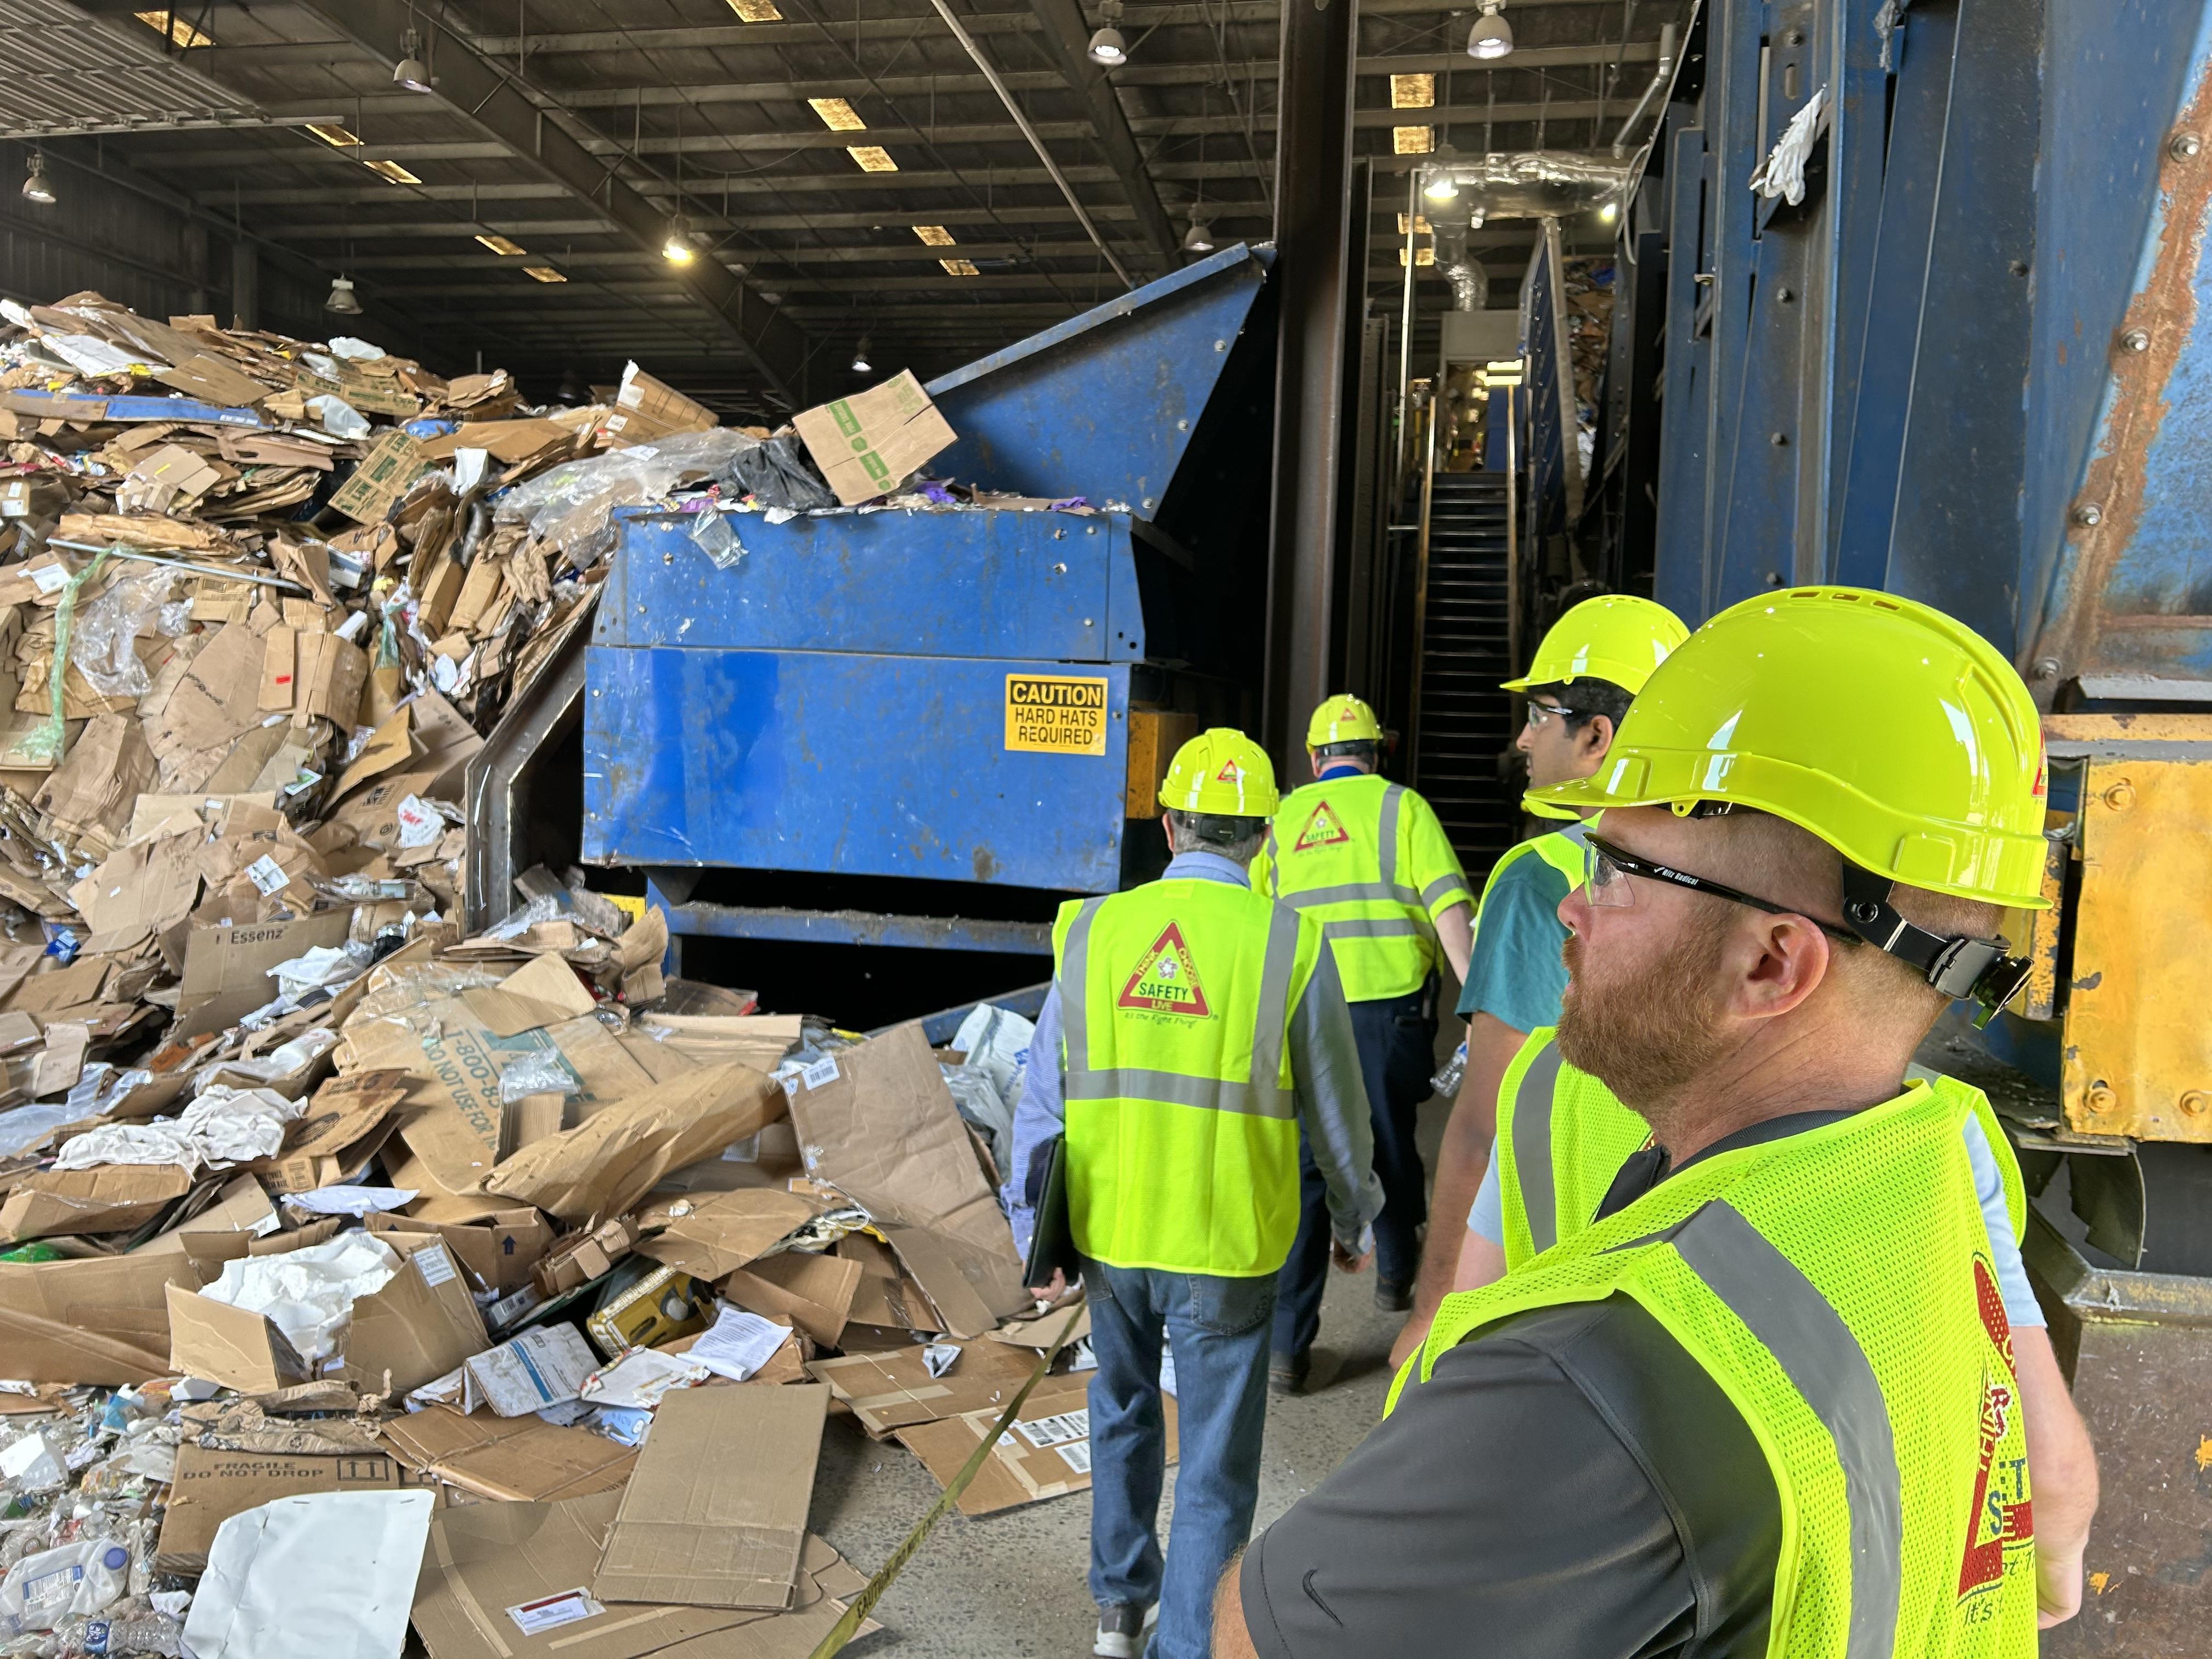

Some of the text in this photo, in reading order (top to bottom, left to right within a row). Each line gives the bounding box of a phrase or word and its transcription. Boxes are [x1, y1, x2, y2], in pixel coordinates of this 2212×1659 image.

[1013, 682, 1101, 706] CAUTION
[1015, 707, 1097, 726] HARD HATS
[1019, 726, 1093, 745] REQUIRED
[1306, 830, 1334, 841] SAFETY
[1674, 873, 1699, 885] Radical
[231, 928, 283, 945] Essenz
[1135, 949, 1159, 977] THINK
[1139, 982, 1188, 1001] SAFETY
[1150, 999, 1174, 1011] LIVE
[1152, 1014, 1172, 1025] Right
[1175, 1017, 1197, 1029] Thing
[435, 1060, 465, 1088] NOT
[451, 1087, 479, 1111] USE
[465, 1109, 495, 1135] FOR
[183, 1470, 211, 1480] DO
[268, 1469, 324, 1477] DROP
[213, 1461, 296, 1471] FRAGILE
[1963, 1596, 1993, 1629] It's
